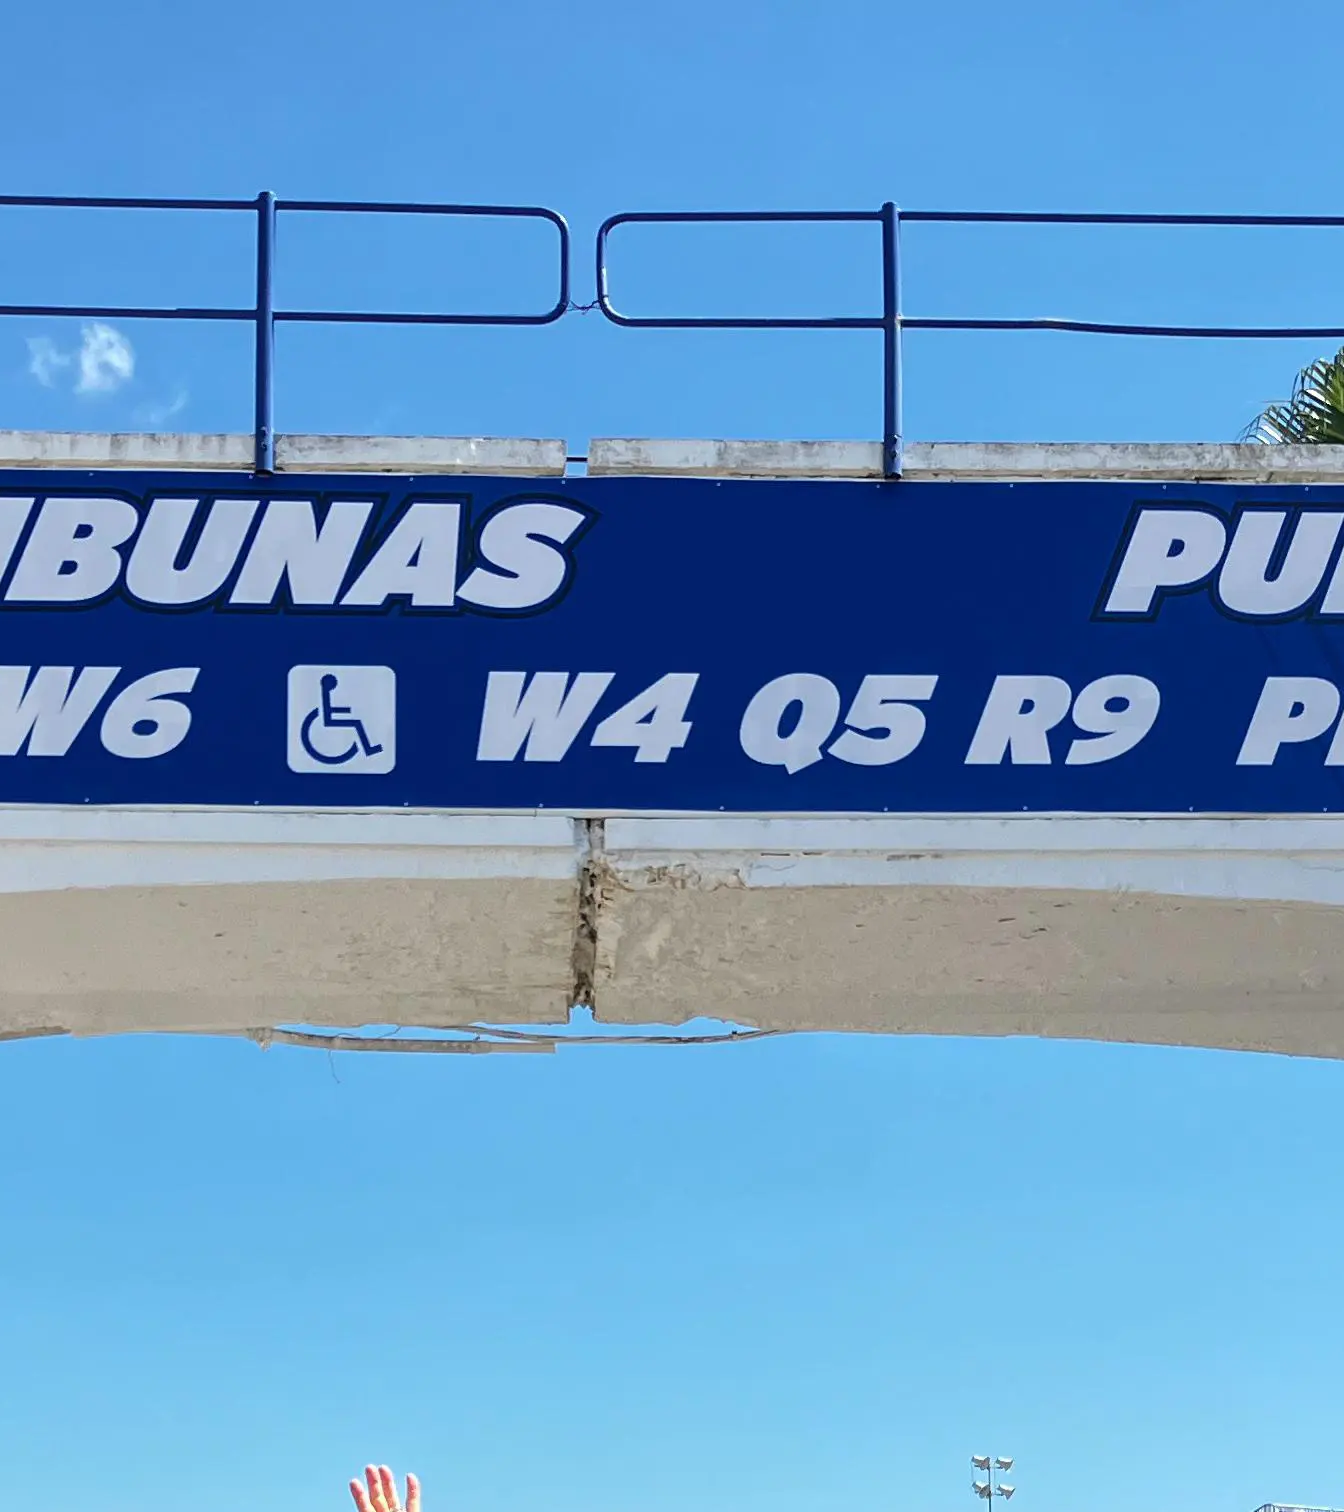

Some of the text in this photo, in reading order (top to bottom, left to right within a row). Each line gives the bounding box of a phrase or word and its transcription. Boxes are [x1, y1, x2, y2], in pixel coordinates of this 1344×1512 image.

[475, 670, 701, 764] W4
[739, 672, 940, 776] Q5
[963, 674, 1161, 766] R9
